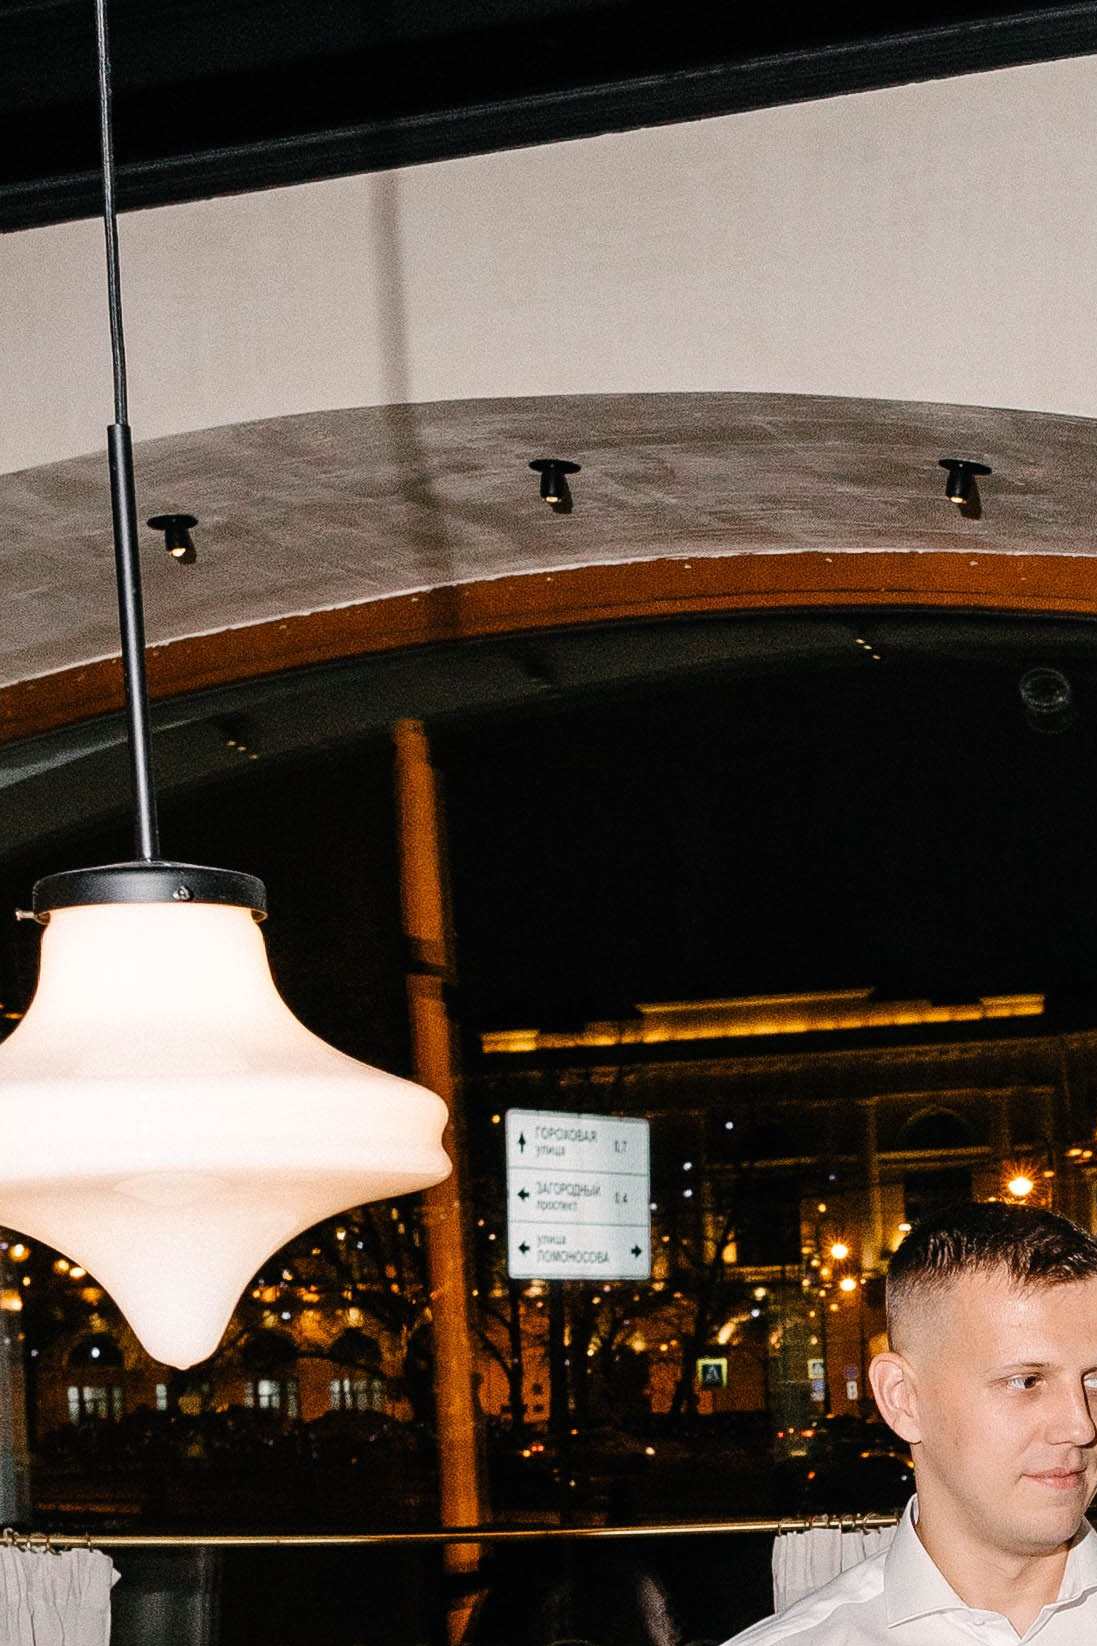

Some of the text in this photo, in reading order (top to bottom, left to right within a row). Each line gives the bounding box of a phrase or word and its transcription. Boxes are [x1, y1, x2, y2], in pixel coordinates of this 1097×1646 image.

[535, 1126, 598, 1142] ГОРОХОВАЯ
[535, 1145, 566, 1158] улица
[536, 1200, 579, 1212] проспект
[537, 1233, 567, 1247] улица
